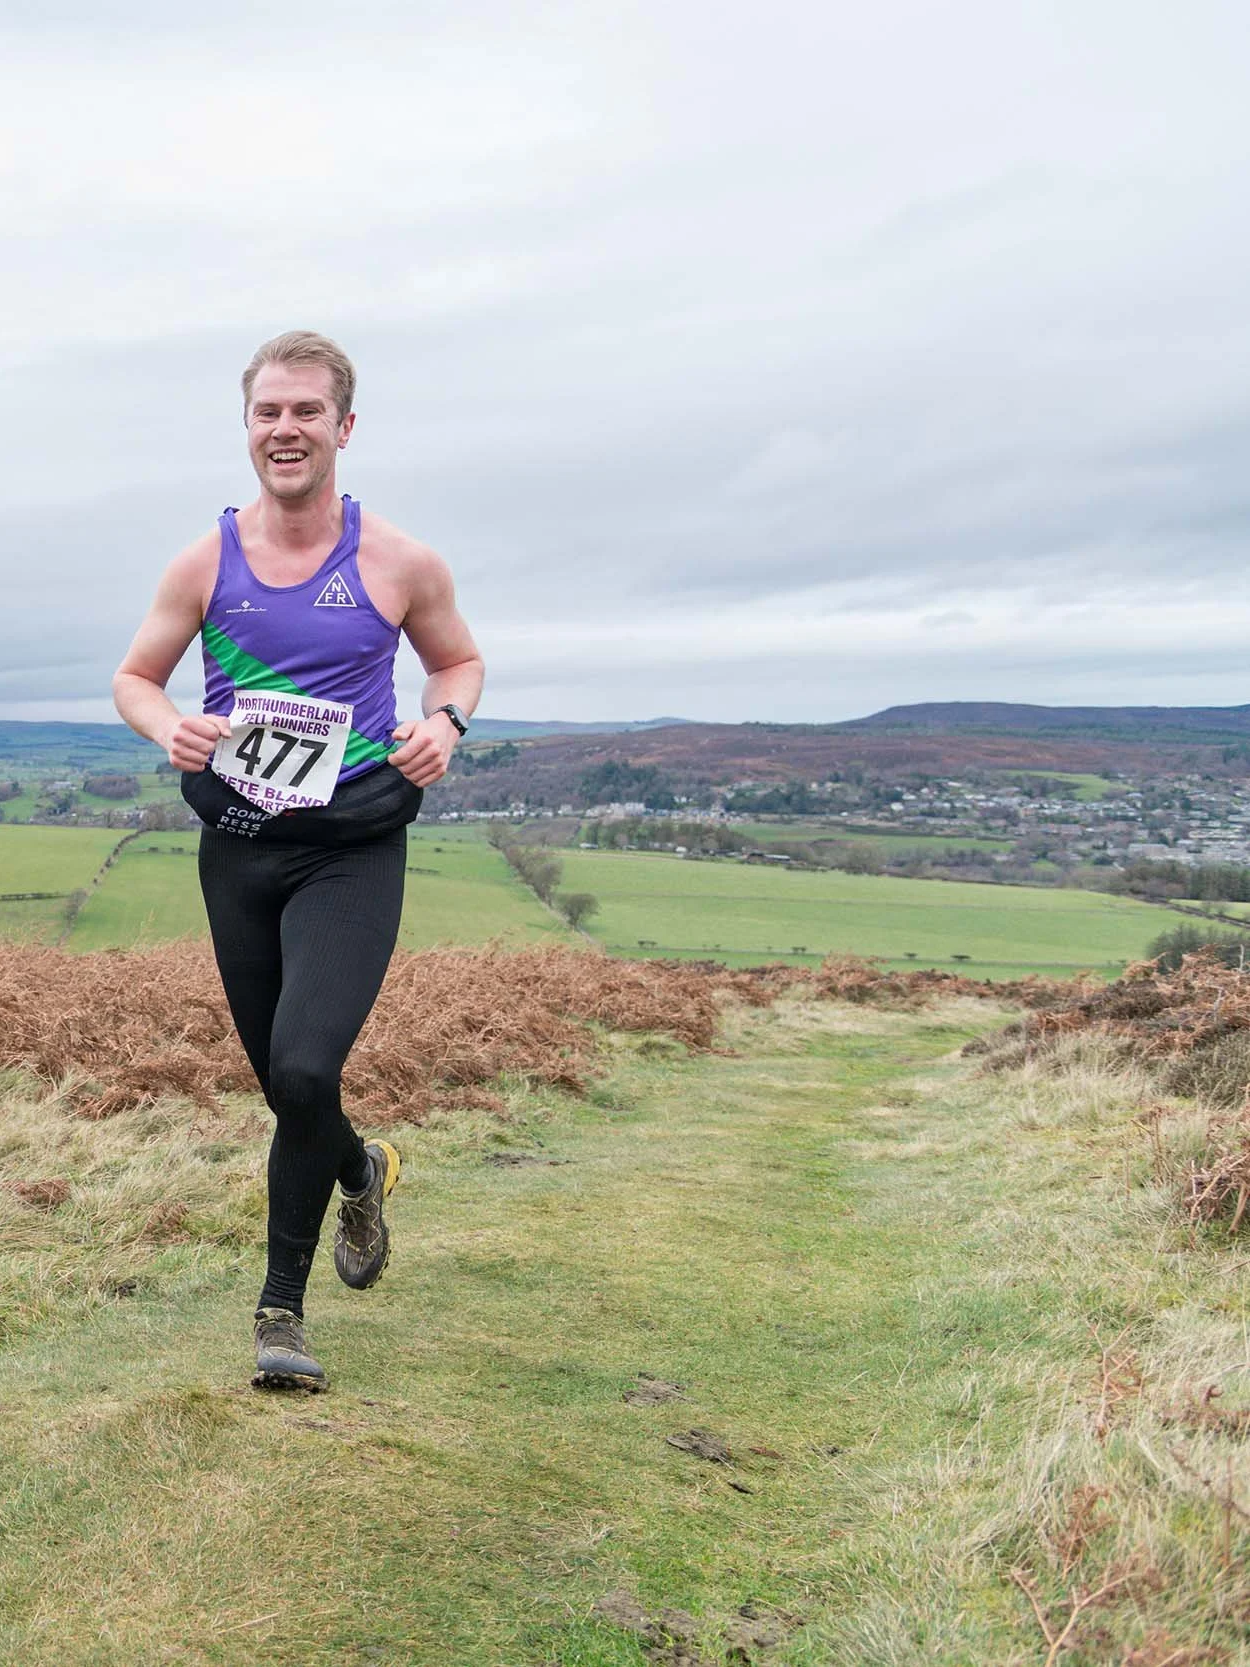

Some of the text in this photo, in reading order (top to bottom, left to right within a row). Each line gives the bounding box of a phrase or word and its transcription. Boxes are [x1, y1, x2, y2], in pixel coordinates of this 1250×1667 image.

[331, 581, 342, 592] N
[238, 697, 348, 725] NORTHUMBERLAND
[242, 713, 330, 737] FELL RUNNERS
[235, 727, 329, 788] 477
[226, 806, 273, 822] COMP
[216, 823, 258, 838] PORT
[220, 815, 261, 831] RESS
